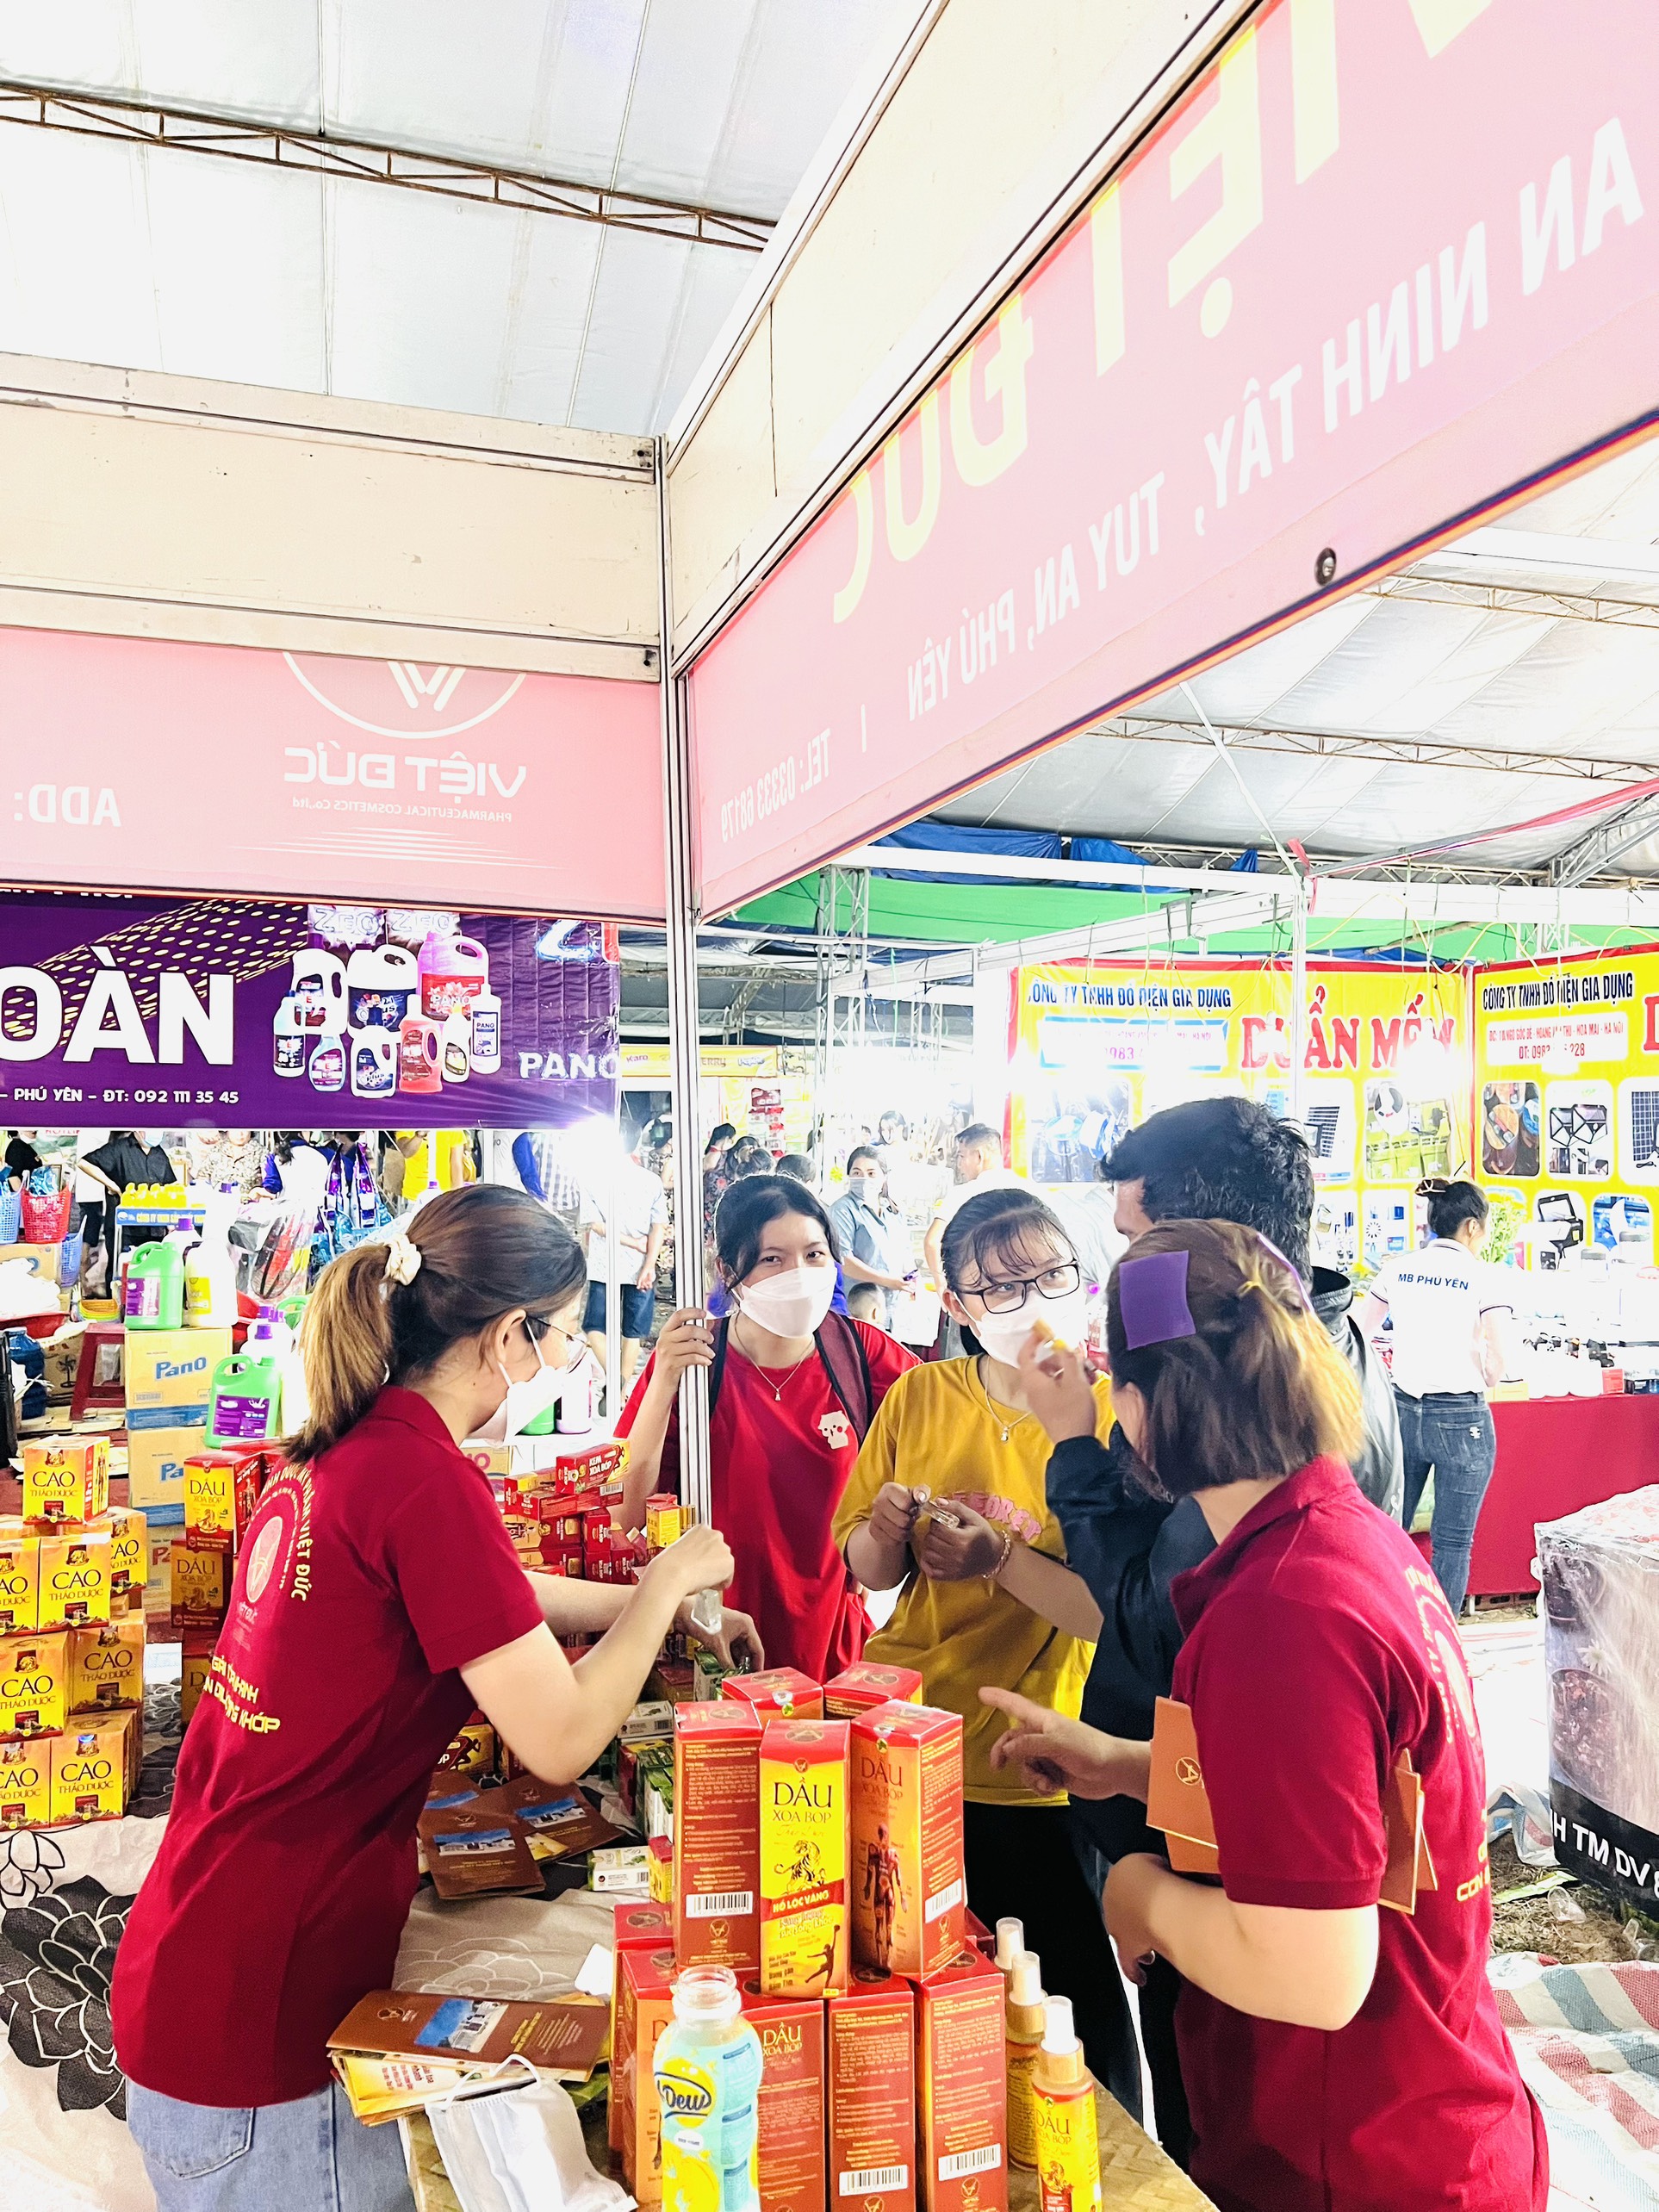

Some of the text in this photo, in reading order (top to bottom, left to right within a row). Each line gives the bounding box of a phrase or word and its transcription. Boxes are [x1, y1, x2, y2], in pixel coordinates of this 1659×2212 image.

[1197, 988, 1232, 1013] DỤNG
[1506, 985, 1517, 1010] TY
[1519, 983, 1541, 1006] TNHH
[1581, 976, 1600, 1002] GIA
[1603, 972, 1633, 1005] DỤNG
[14, 1085, 239, 1104] PHÚ YÊN ĐT: 092 111 35 45
[1398, 1273, 1469, 1290] MB PHÚ YÊN
[32, 1470, 76, 1488] CAO
[111, 1539, 140, 1559] AO
[0, 1575, 28, 1594] AO
[53, 1569, 102, 1590] CAO
[290, 1563, 313, 1601] ĐỨC
[84, 1649, 134, 1671] CAO
[1, 1675, 53, 1698] CAO
[0, 1768, 39, 1789] AO
[60, 1760, 113, 1783] CAO
[774, 1776, 832, 1808] DẦU
[772, 1808, 801, 1823] XOA
[1572, 1822, 1610, 1866] TM
[1614, 1846, 1651, 1886] DV
[763, 2022, 802, 2047] DẦU
